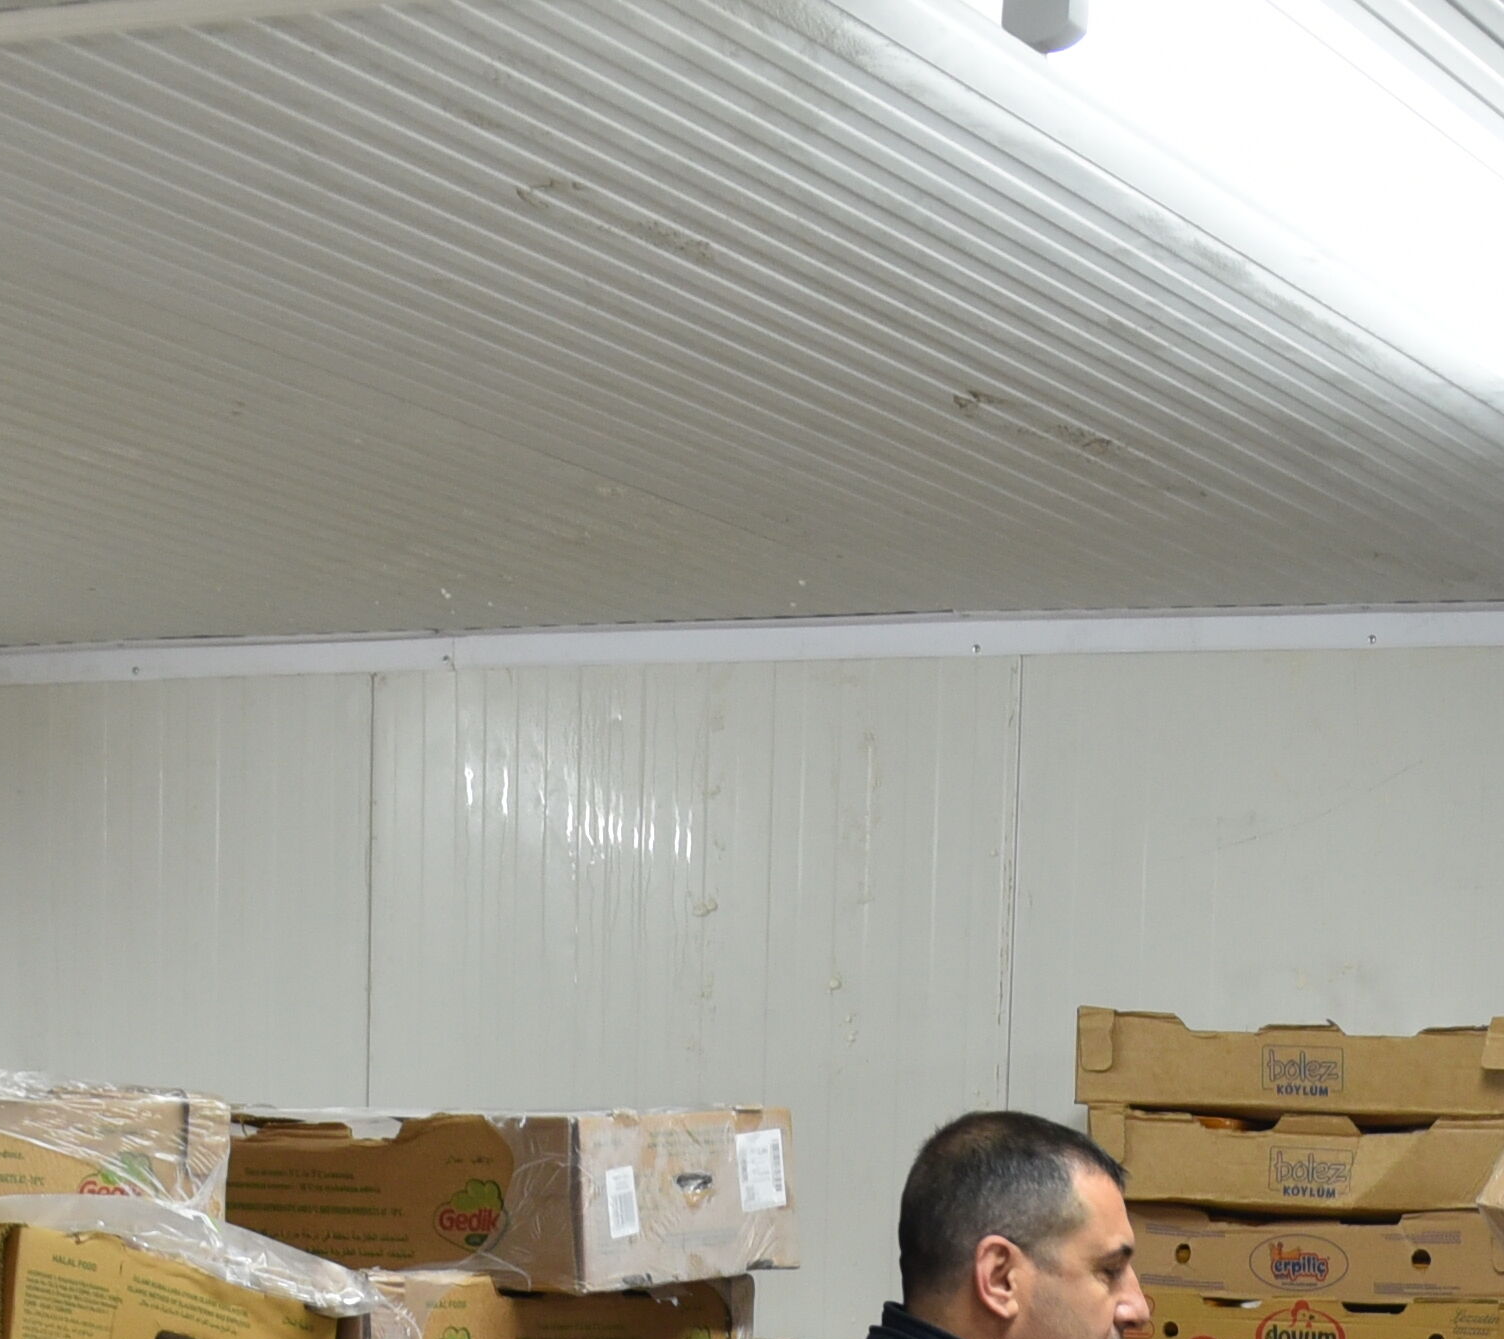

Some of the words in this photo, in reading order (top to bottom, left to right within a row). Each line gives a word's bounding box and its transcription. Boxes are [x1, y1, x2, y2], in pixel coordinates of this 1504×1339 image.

[1265, 1048, 1340, 1083] bolez
[1273, 1148, 1348, 1185] bolez
[438, 1206, 501, 1234] Gedik
[1272, 1254, 1329, 1279] erpiliç
